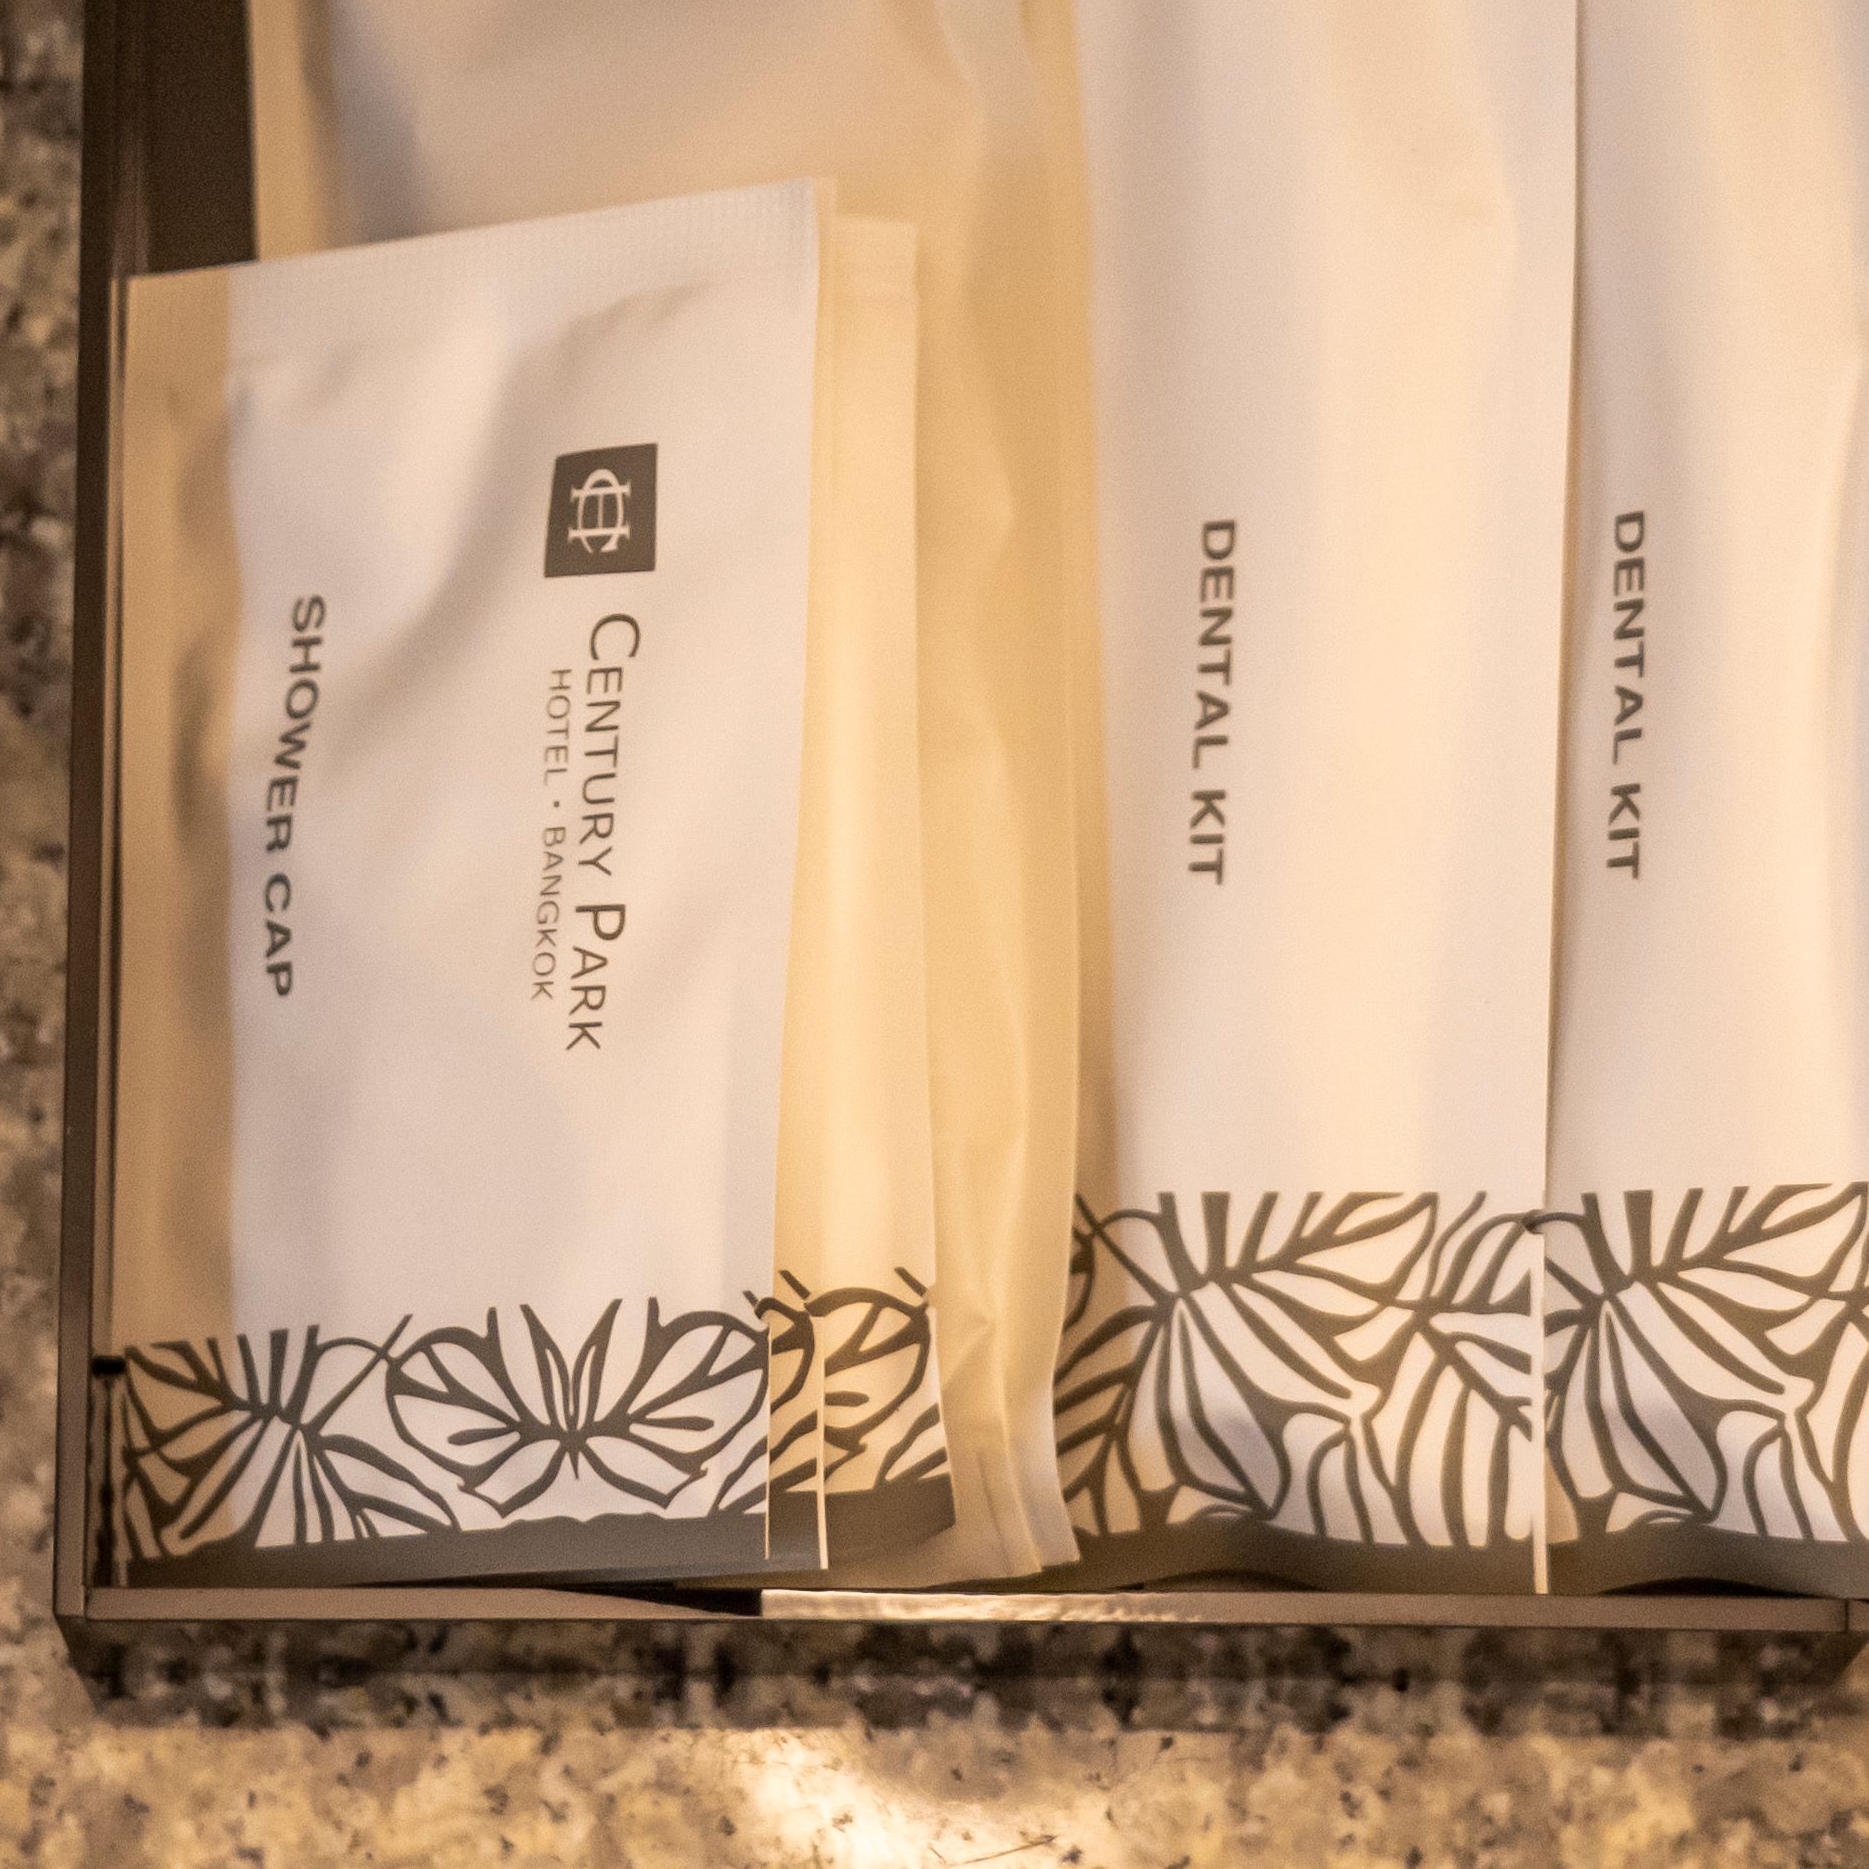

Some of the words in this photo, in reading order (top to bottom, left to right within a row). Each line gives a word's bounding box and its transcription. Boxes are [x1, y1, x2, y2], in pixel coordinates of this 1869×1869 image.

[1192, 518, 1237, 770] DENTAL
[1612, 510, 1645, 765] DENTAL
[265, 594, 327, 853] SHOWER
[544, 669, 573, 787] HOTEL
[1187, 788, 1228, 886] KIT
[1606, 783, 1641, 880] KIT
[264, 872, 294, 998] CAP
[531, 826, 566, 1000] BANGKOK
